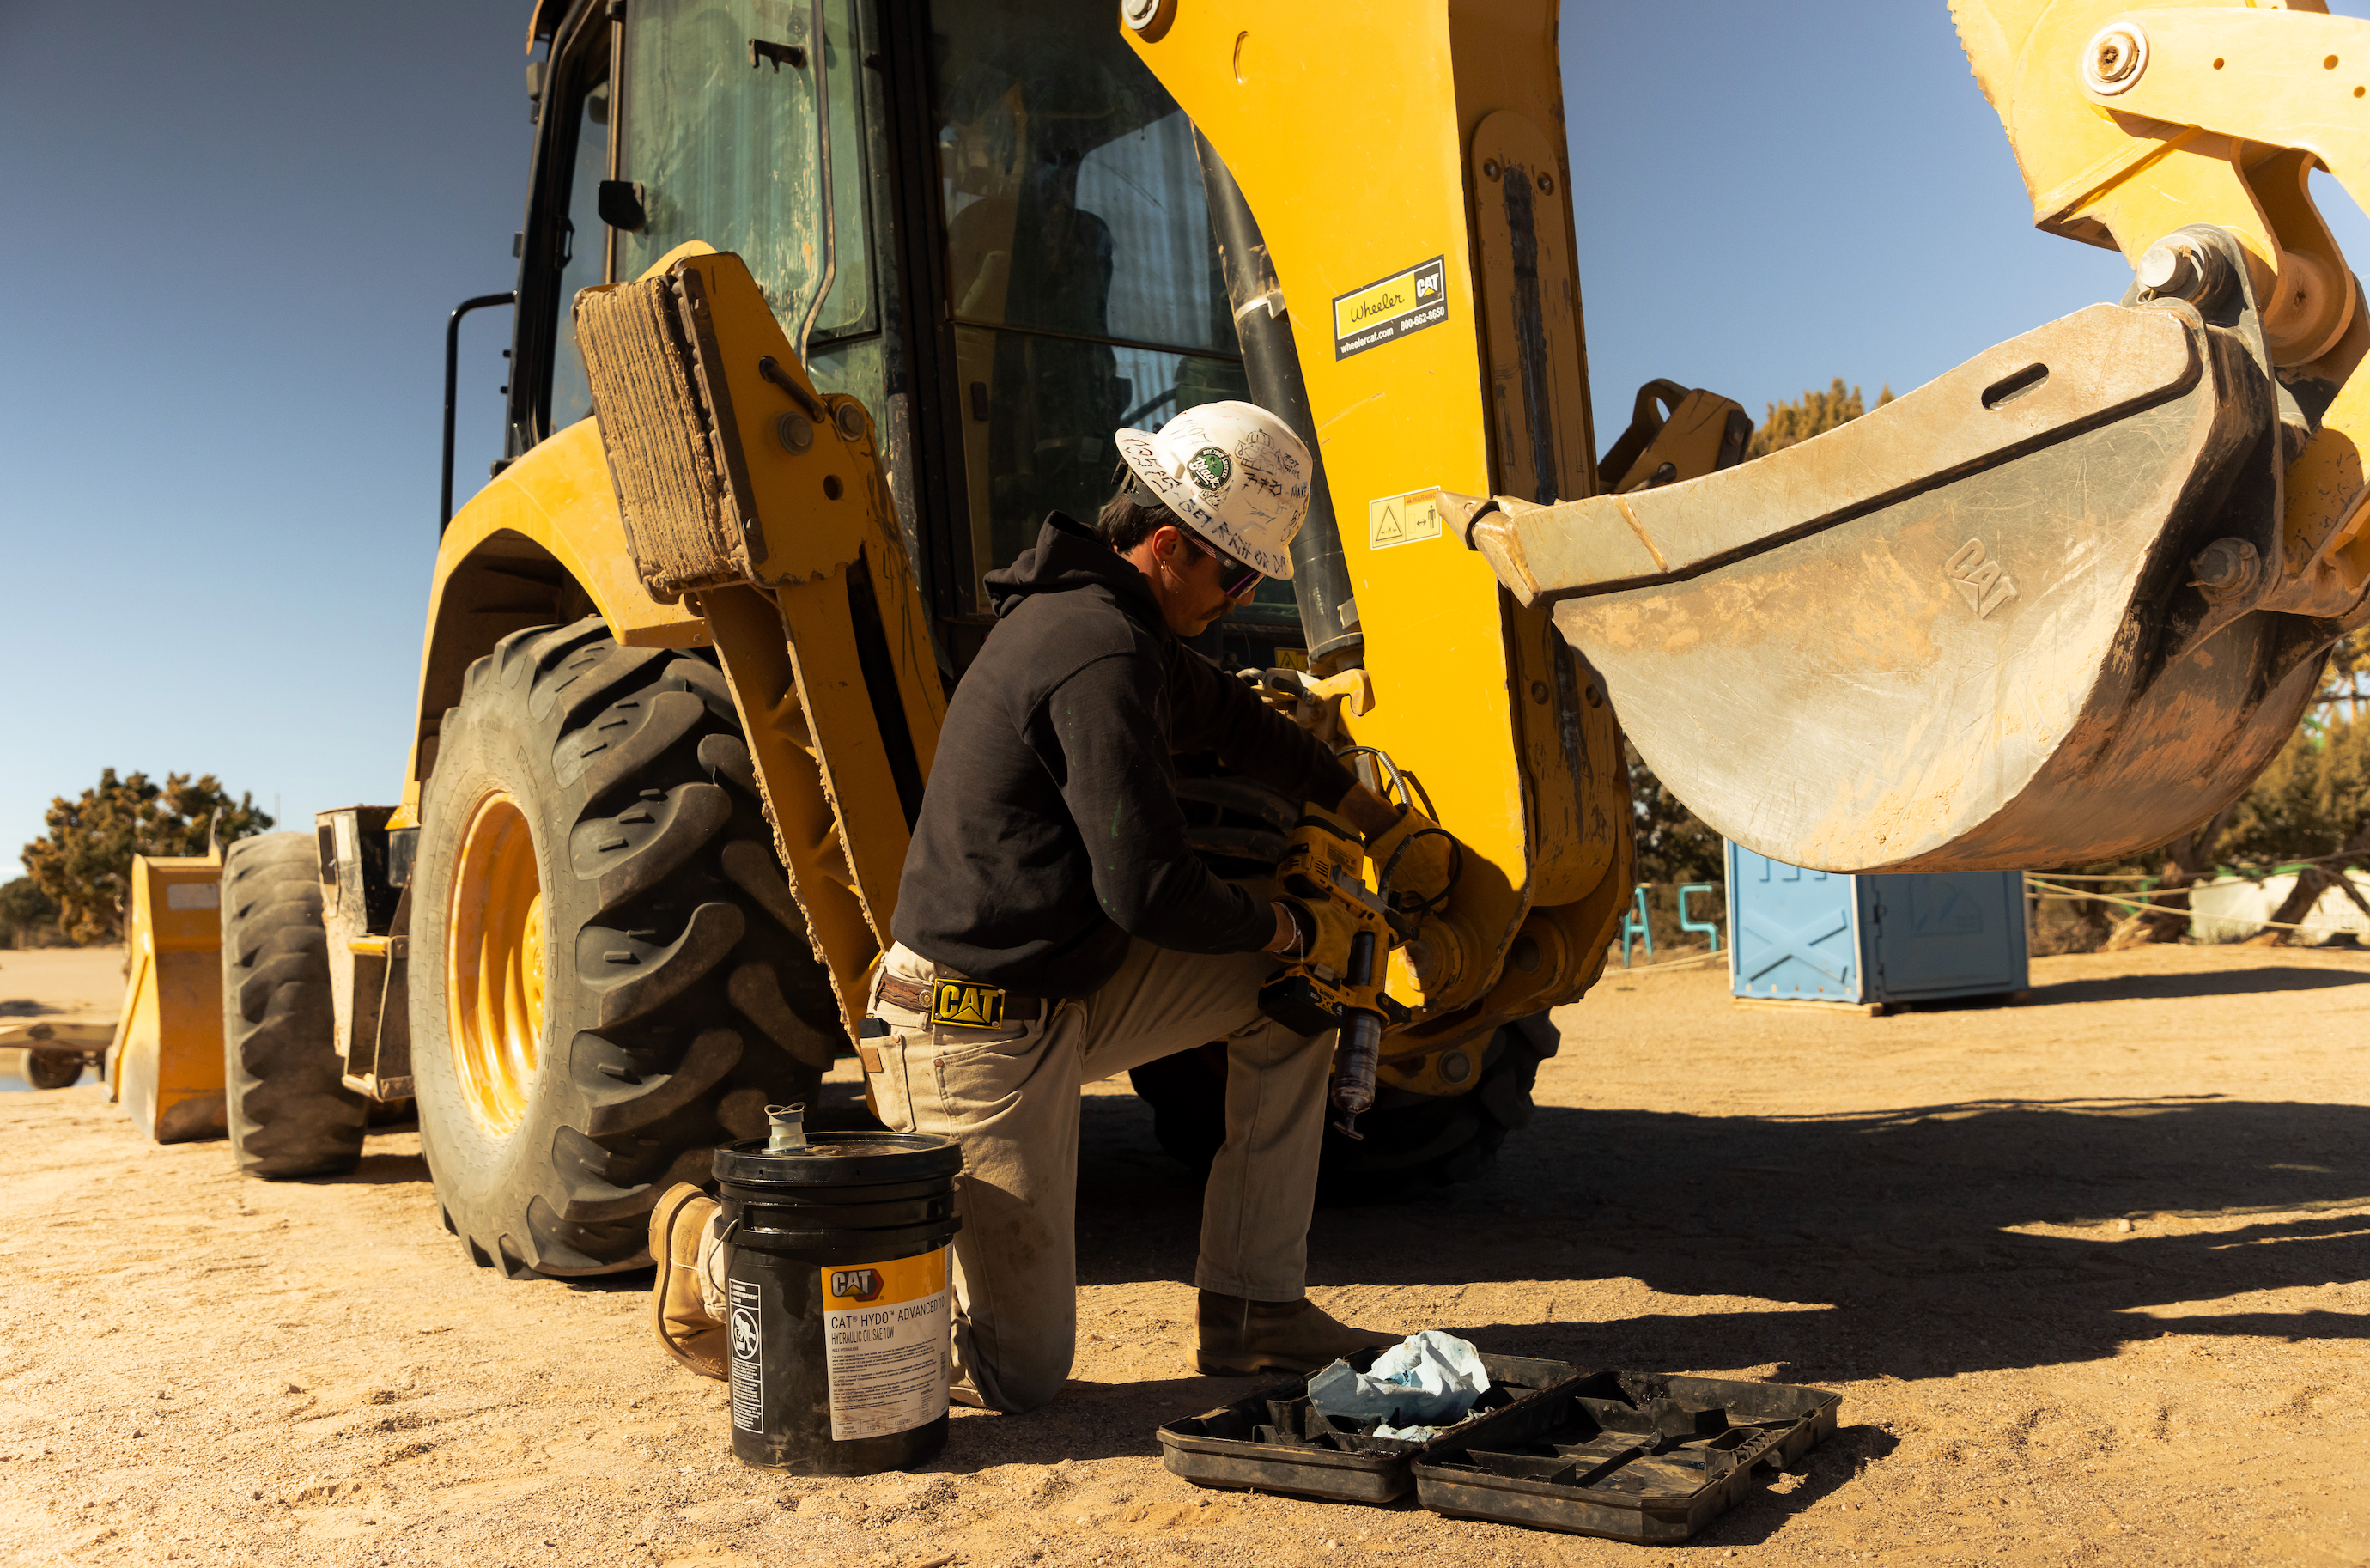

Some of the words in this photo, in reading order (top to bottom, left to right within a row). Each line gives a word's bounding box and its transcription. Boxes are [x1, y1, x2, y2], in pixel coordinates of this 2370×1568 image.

[1417, 272, 1439, 298] CAT
[1351, 293, 1405, 323] Wheeler
[1340, 326, 1394, 354] wheelercat.com
[1400, 306, 1445, 331] 800-662-8650
[1188, 456, 1219, 489] Black
[1945, 538, 2018, 621] CAT
[939, 984, 999, 1024] CAT
[831, 1270, 872, 1297] CAT
[897, 1299, 939, 1322] ADVANCED
[831, 1330, 862, 1346] HYDRAULIC
[863, 1328, 872, 1343] OIL
[872, 1328, 883, 1340] SAE
[884, 1326, 895, 1339] 10W
